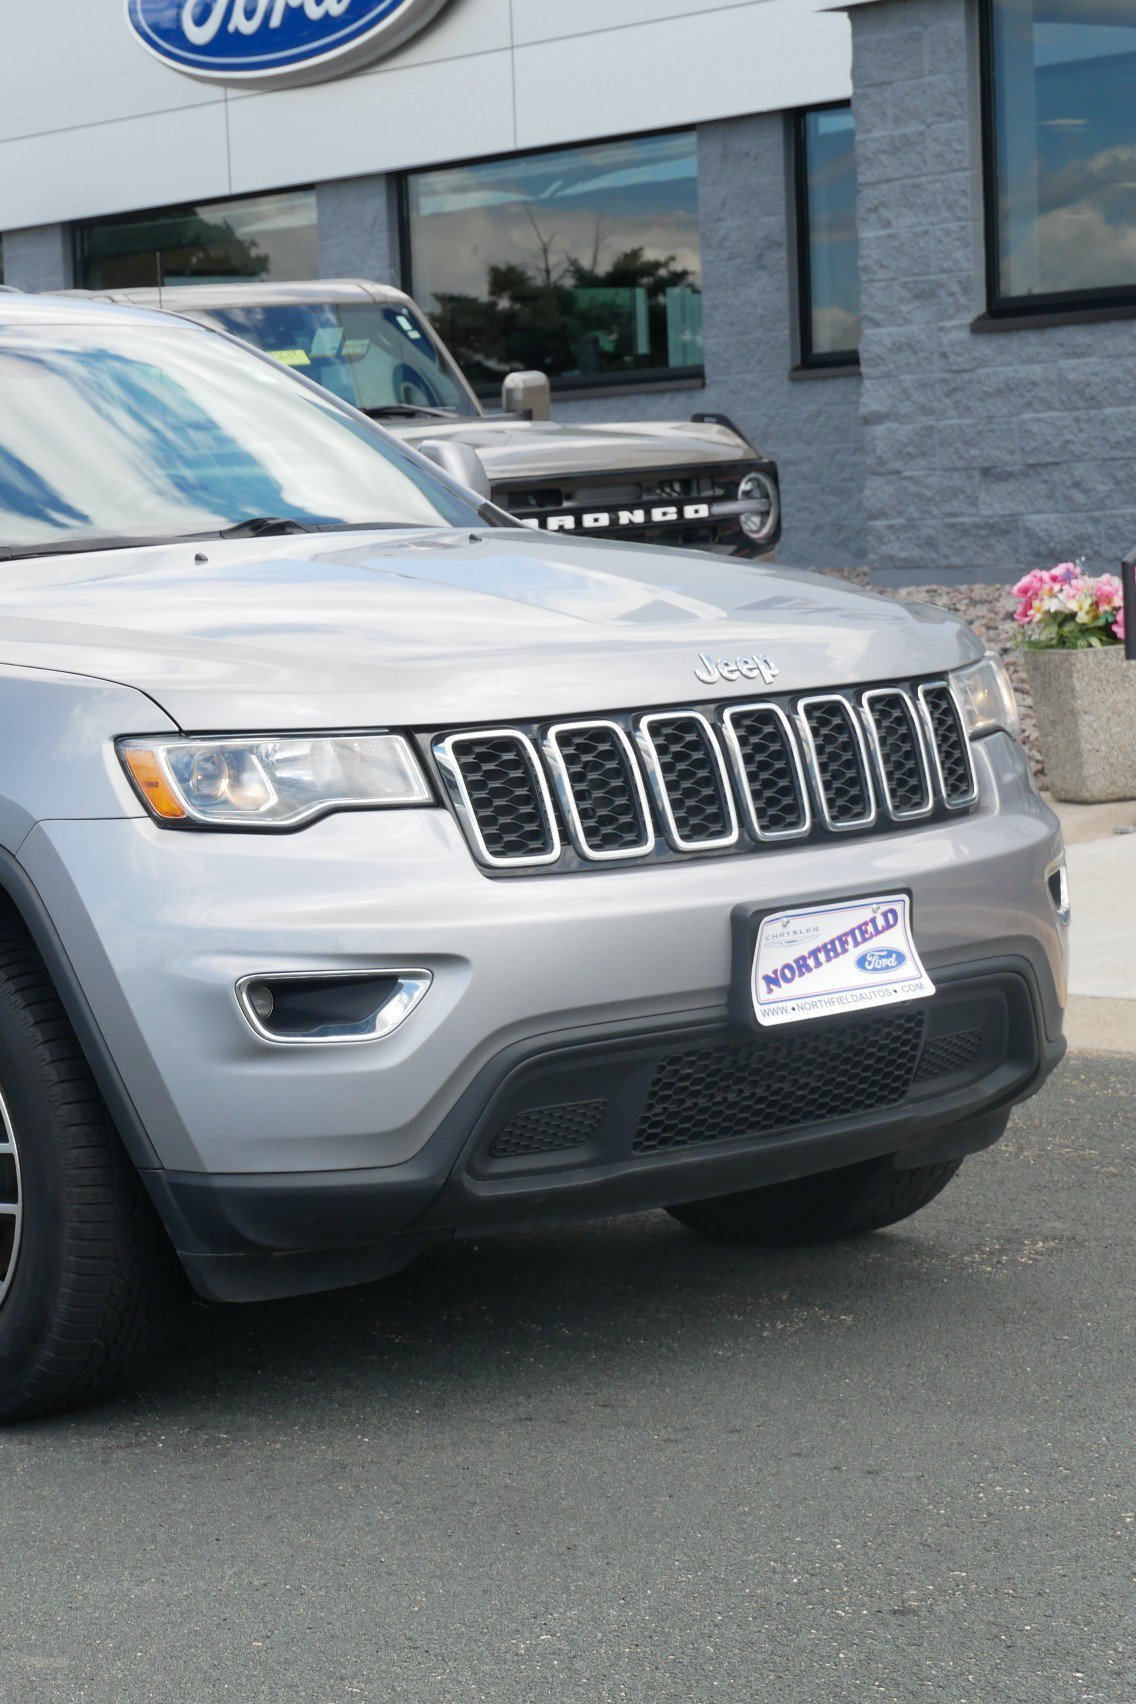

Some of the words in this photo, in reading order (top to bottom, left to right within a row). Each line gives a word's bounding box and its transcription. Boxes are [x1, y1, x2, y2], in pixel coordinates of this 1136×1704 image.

[694, 652, 780, 684] Jeep
[765, 926, 819, 941] CHRYSLER
[761, 907, 899, 995] NORTHFIELD
[865, 951, 897, 969] Ford
